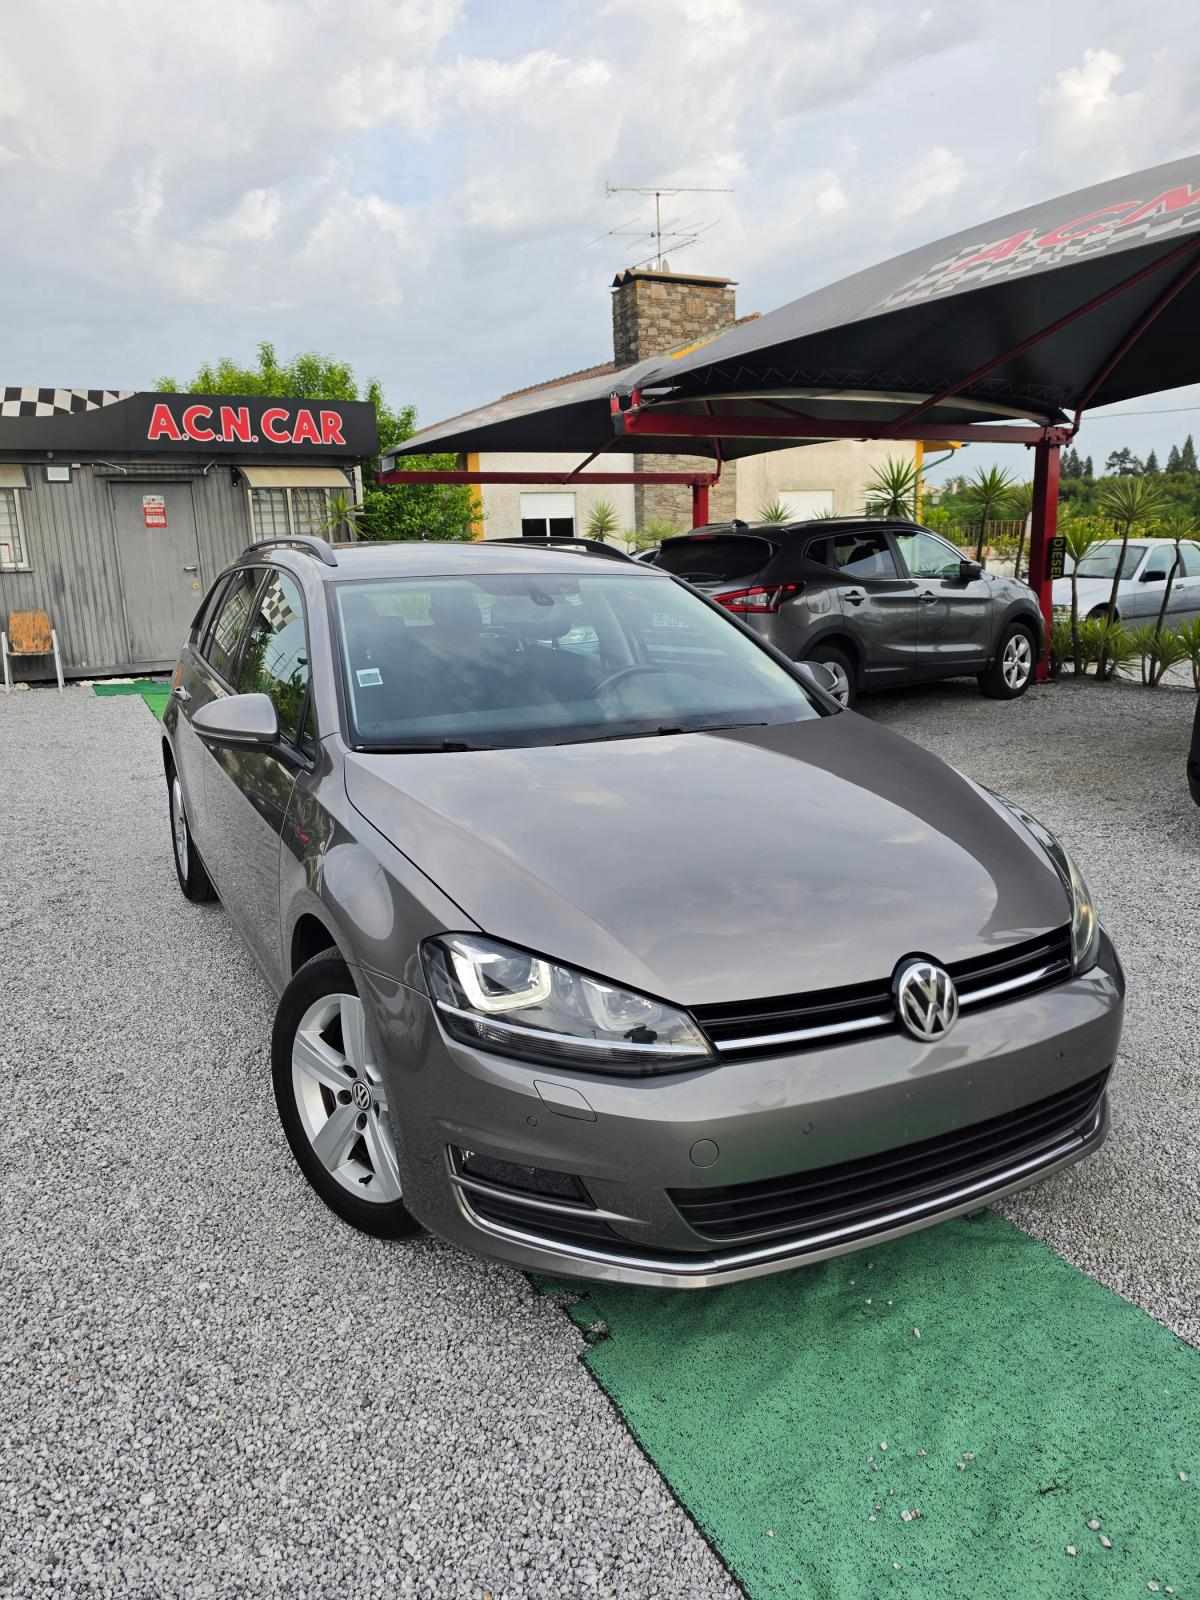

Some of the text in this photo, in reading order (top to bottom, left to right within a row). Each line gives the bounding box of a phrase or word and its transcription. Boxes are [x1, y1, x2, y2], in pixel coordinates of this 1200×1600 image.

[148, 403, 346, 445] A.C.N. CAR
[1050, 538, 1065, 579] DIESEL
